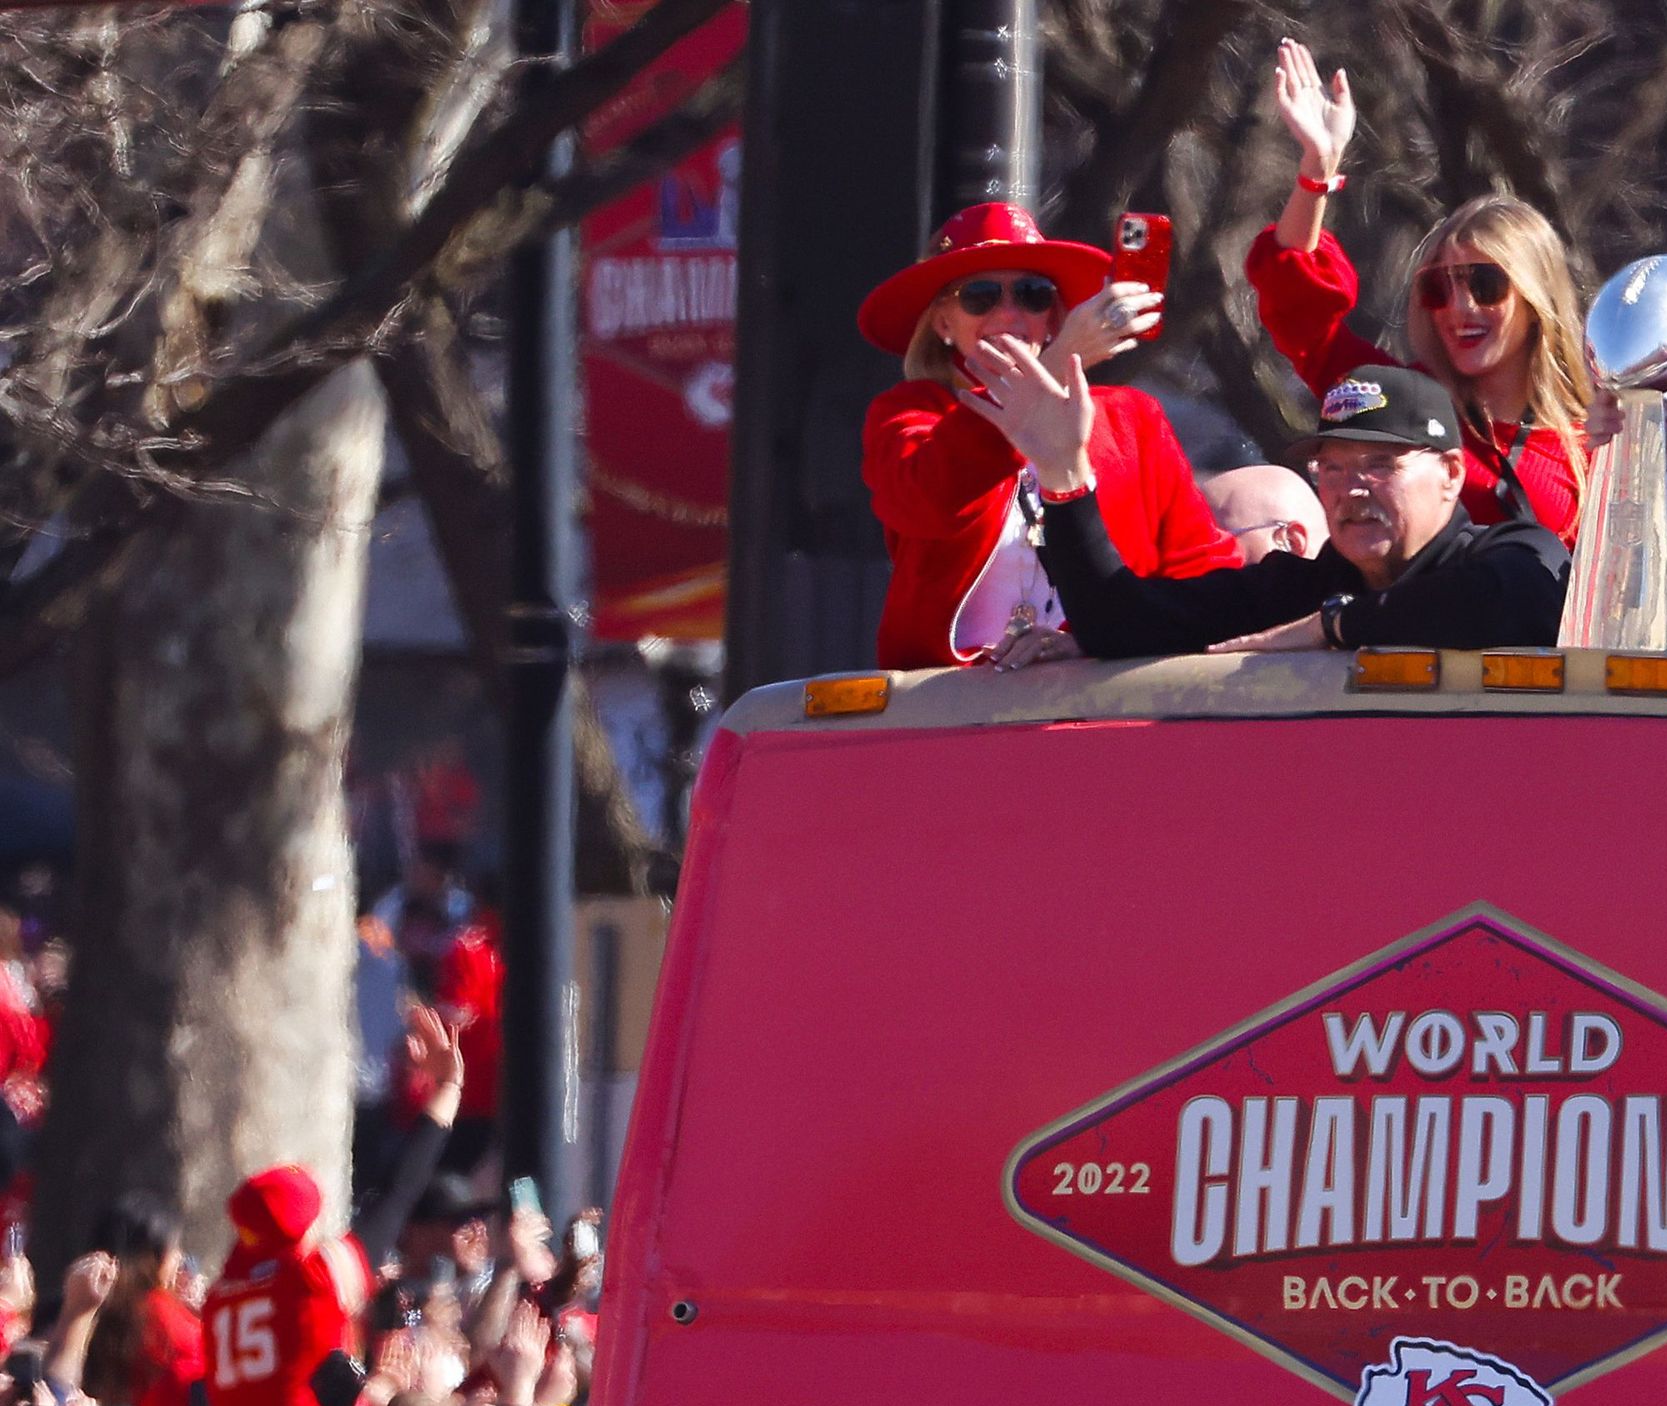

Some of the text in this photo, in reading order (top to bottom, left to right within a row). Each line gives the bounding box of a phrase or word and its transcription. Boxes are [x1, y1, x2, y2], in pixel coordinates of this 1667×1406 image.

[1321, 1010, 1625, 1077] WORLD
[1051, 1161, 1151, 1196] 2022
[211, 1296, 276, 1390] 15
